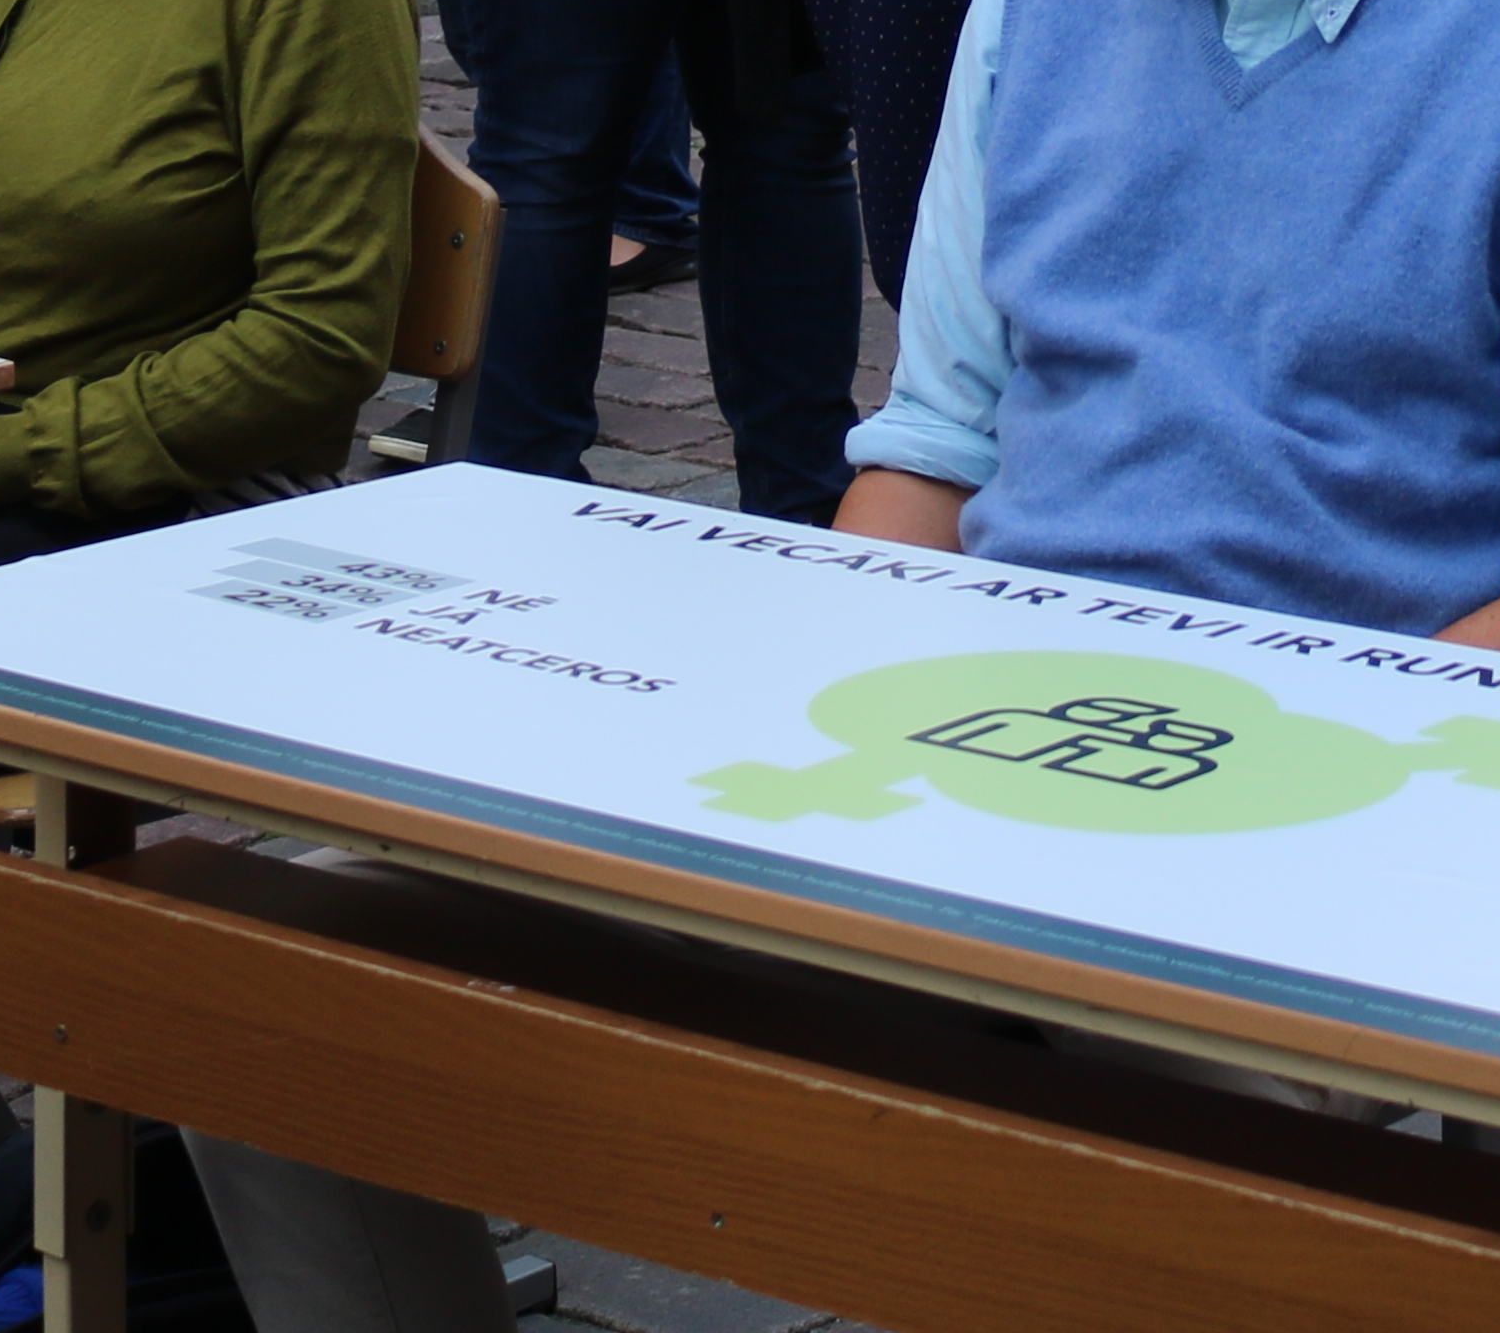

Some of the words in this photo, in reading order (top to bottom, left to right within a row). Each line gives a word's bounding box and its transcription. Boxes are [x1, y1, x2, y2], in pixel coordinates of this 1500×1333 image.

[280, 575, 382, 603] 34%
[408, 605, 490, 625] JĀ
[337, 563, 436, 589] 43%
[464, 589, 555, 612] NĒ
[573, 502, 688, 531] VAI
[697, 525, 953, 583] VECĀKI
[954, 580, 1068, 605] AR
[1080, 598, 1246, 638] TEVI
[1250, 631, 1335, 655] IR
[222, 589, 328, 618] 22%
[356, 618, 676, 693] NEATCEROS
